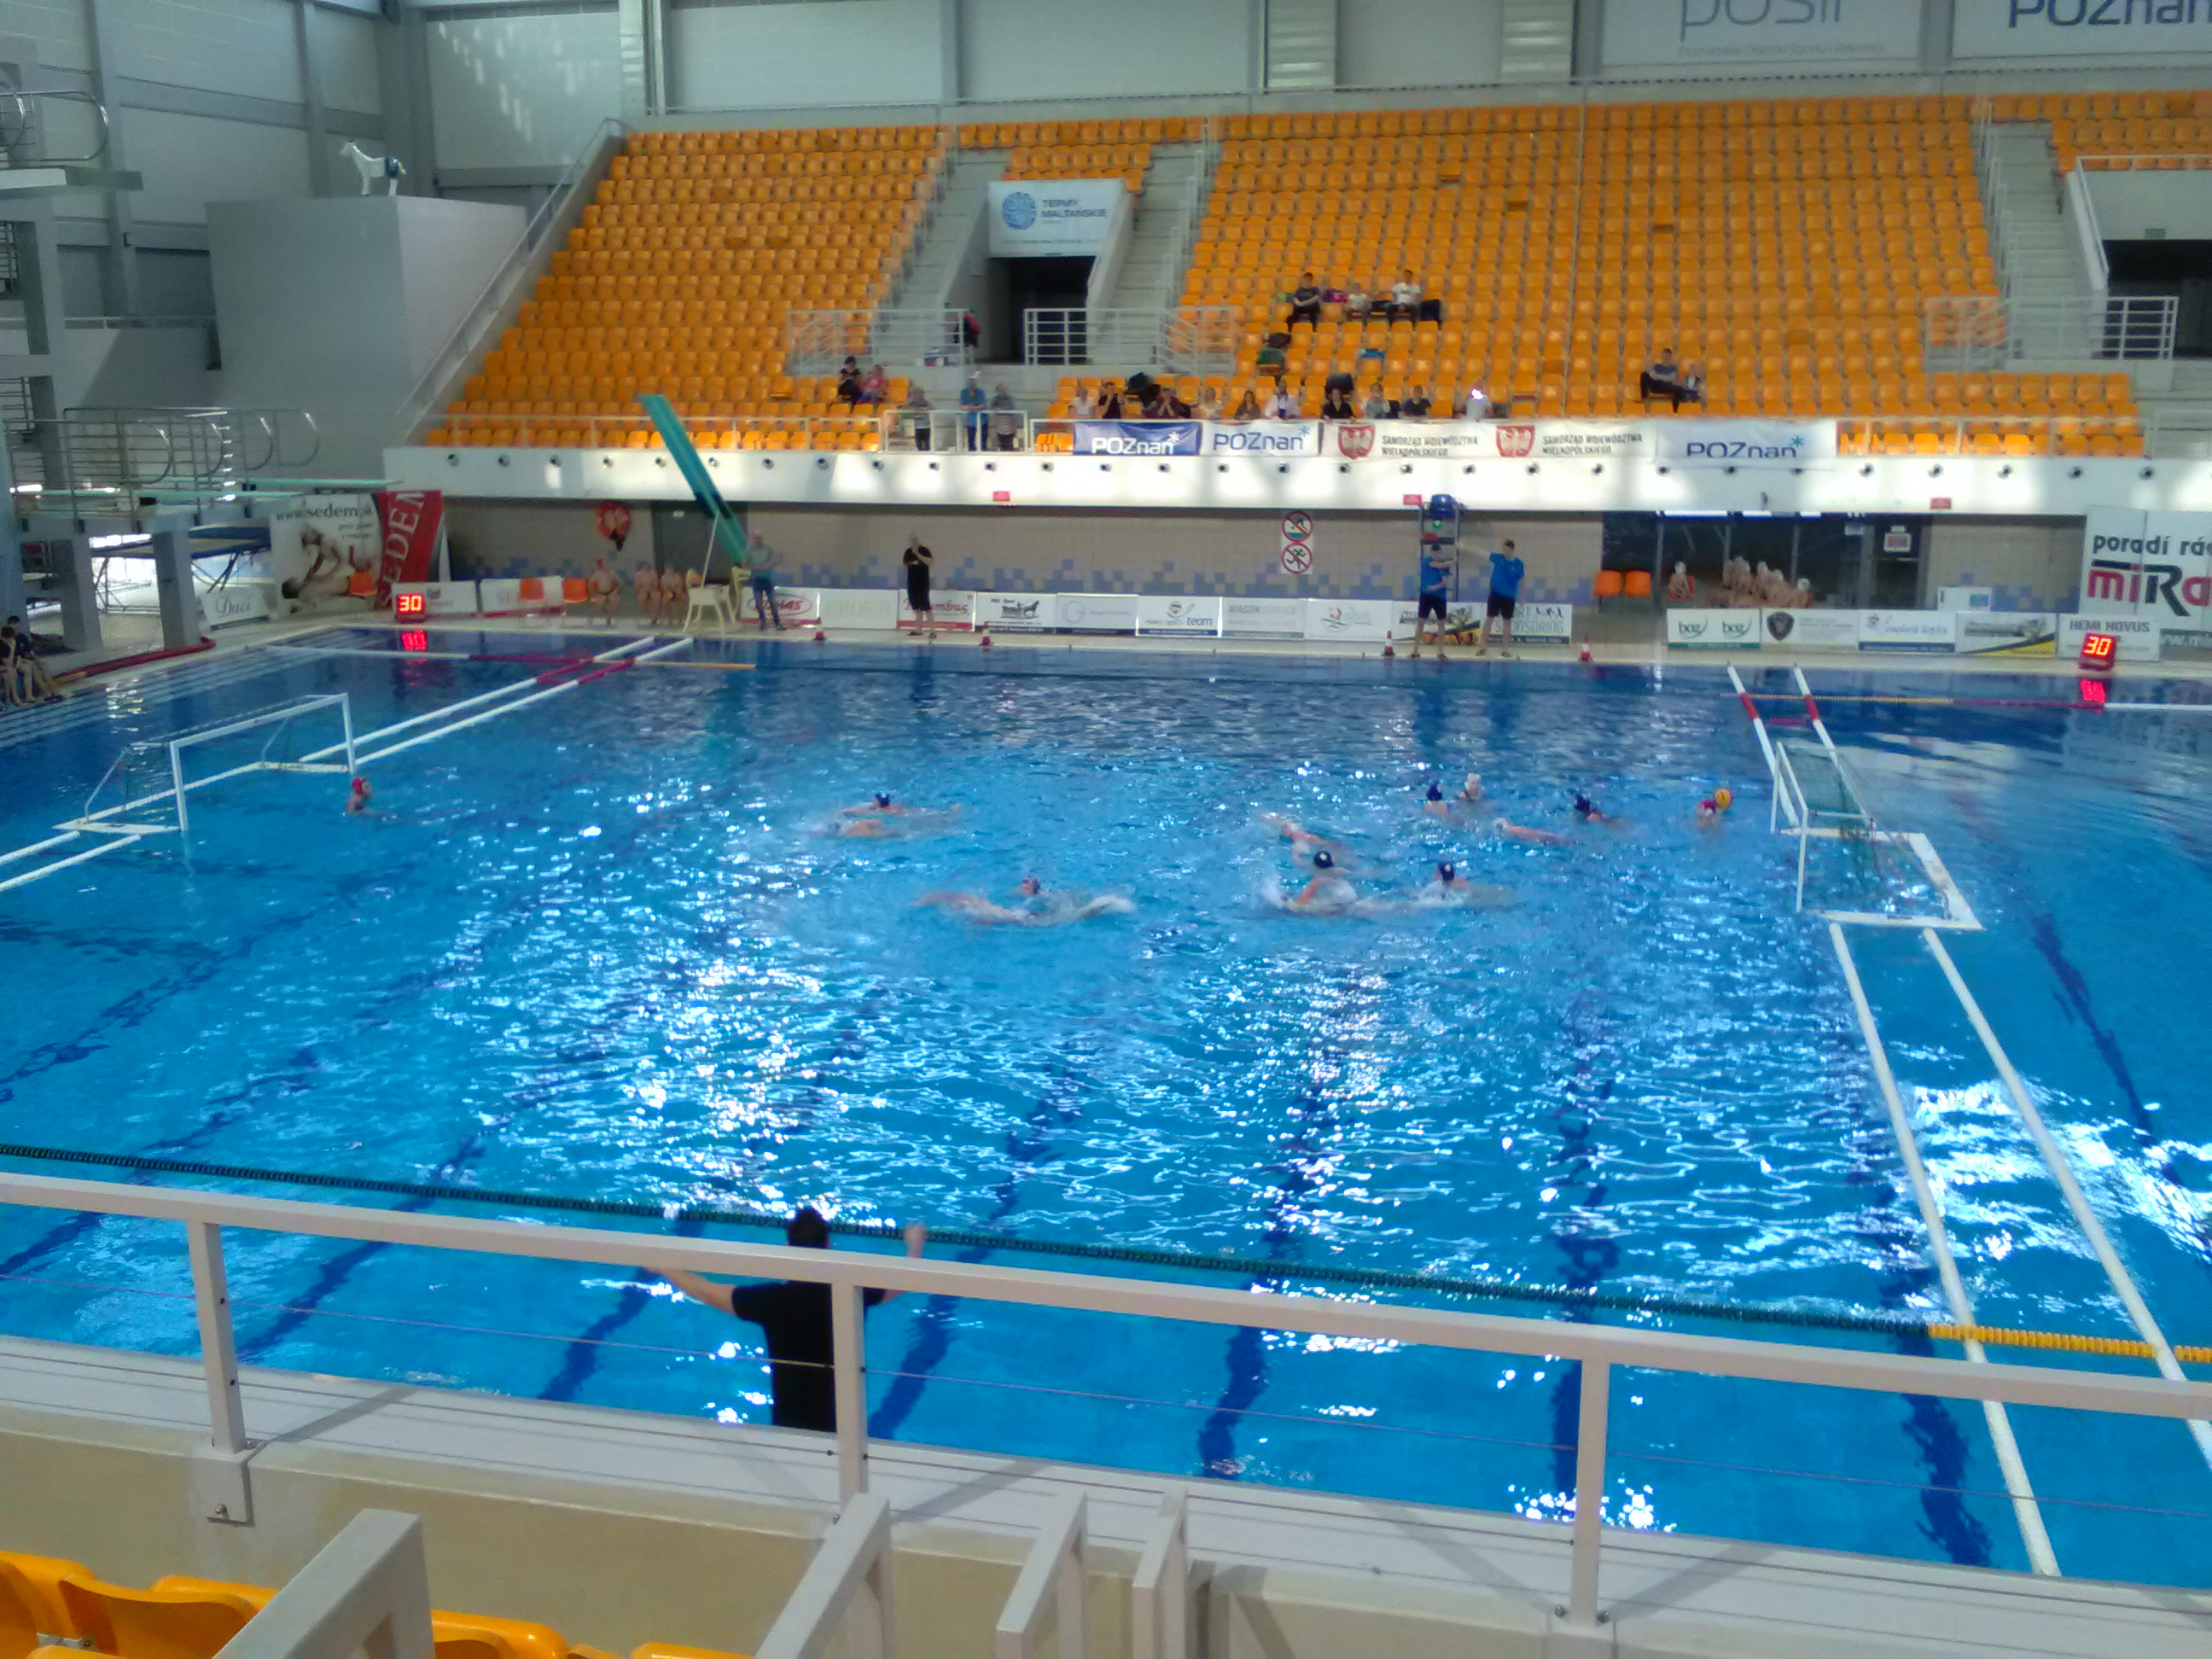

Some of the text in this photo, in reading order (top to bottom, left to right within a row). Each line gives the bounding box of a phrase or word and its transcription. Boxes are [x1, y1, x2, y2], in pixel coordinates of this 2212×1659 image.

[2092, 534, 2172, 555] poradí
[399, 595, 422, 612] 30
[2083, 635, 2113, 656] 30
